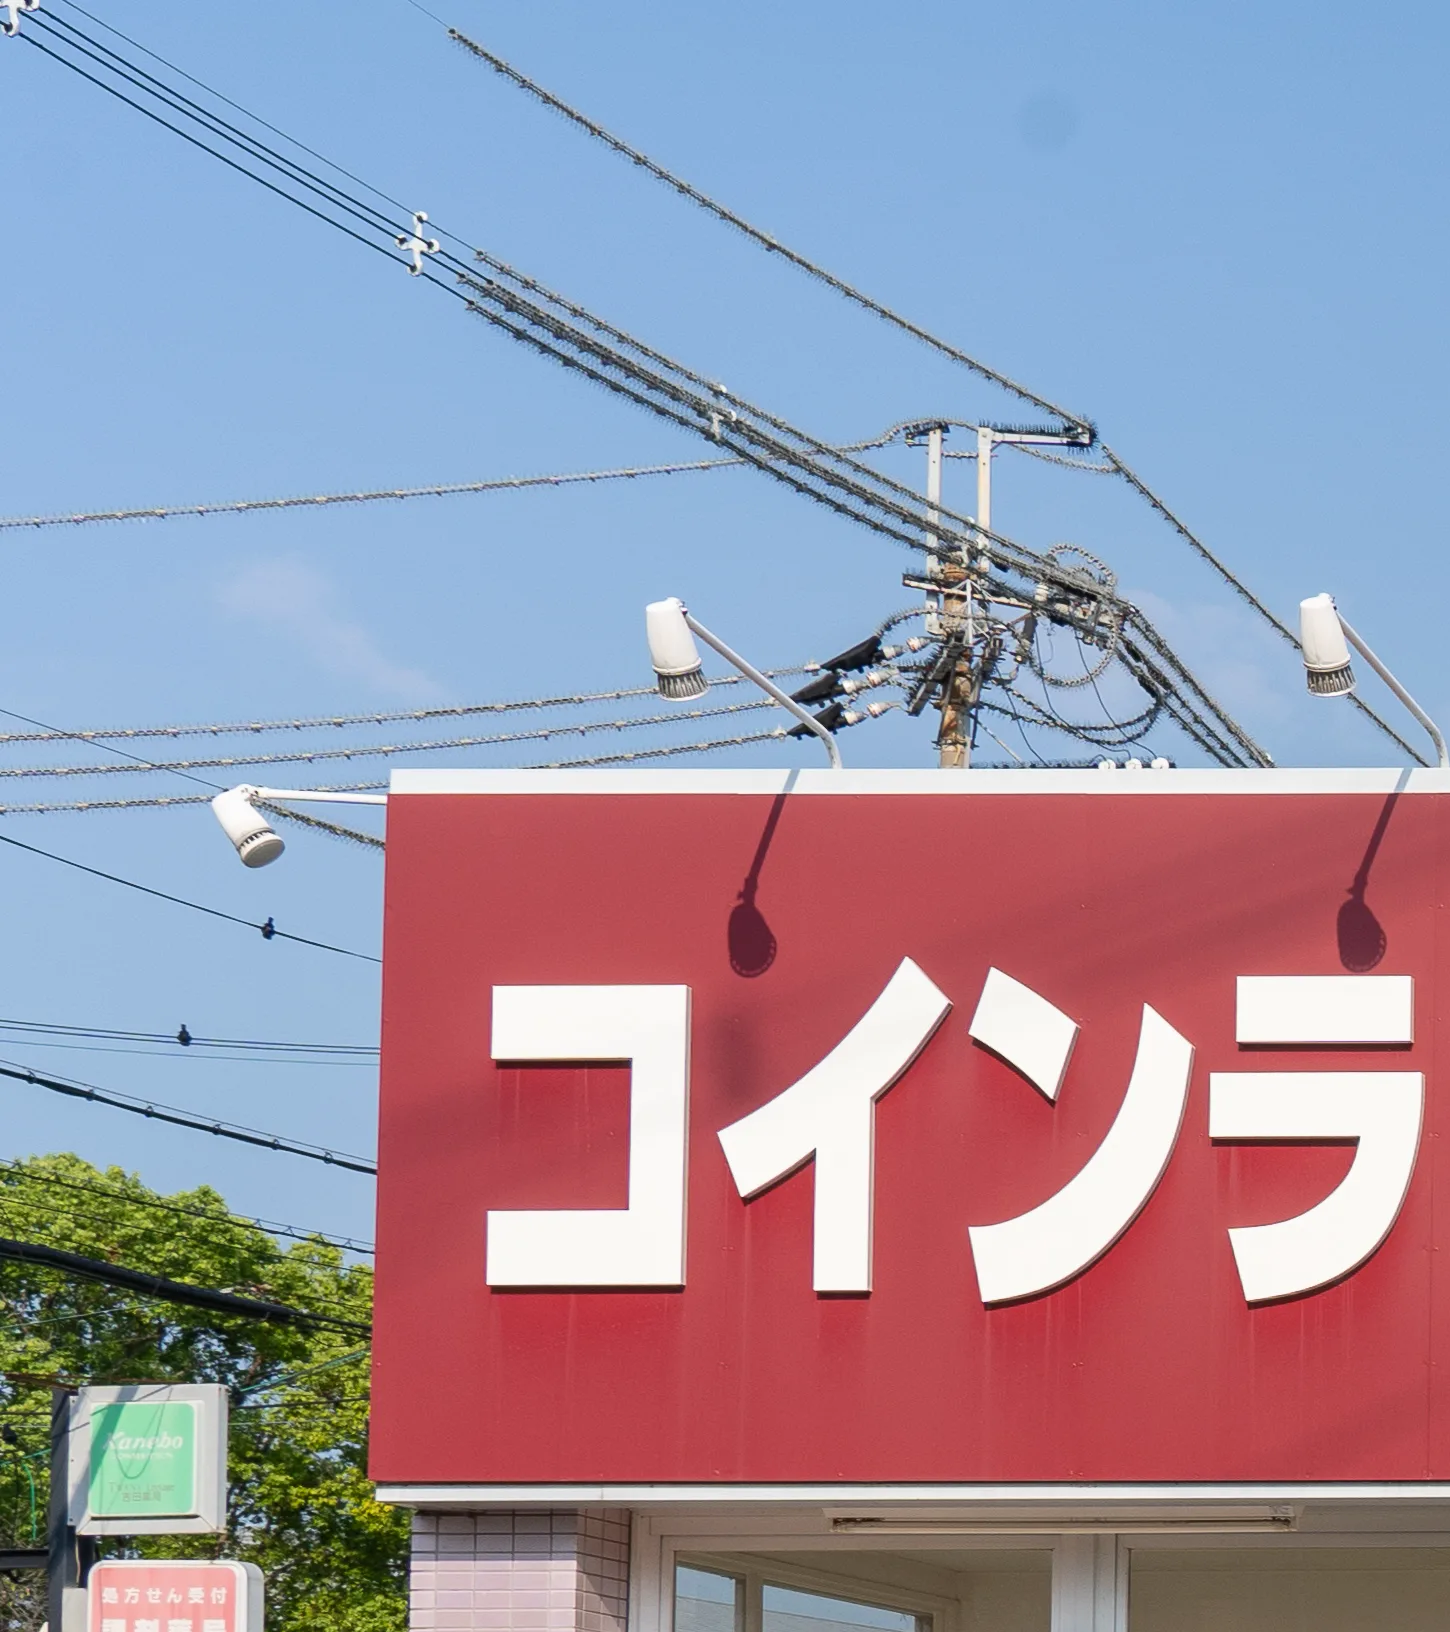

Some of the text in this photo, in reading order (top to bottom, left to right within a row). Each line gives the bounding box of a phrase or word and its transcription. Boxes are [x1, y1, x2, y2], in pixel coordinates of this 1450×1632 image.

[105, 1431, 184, 1450] Kanebo
[102, 1587, 228, 1604] 処方せん受付
